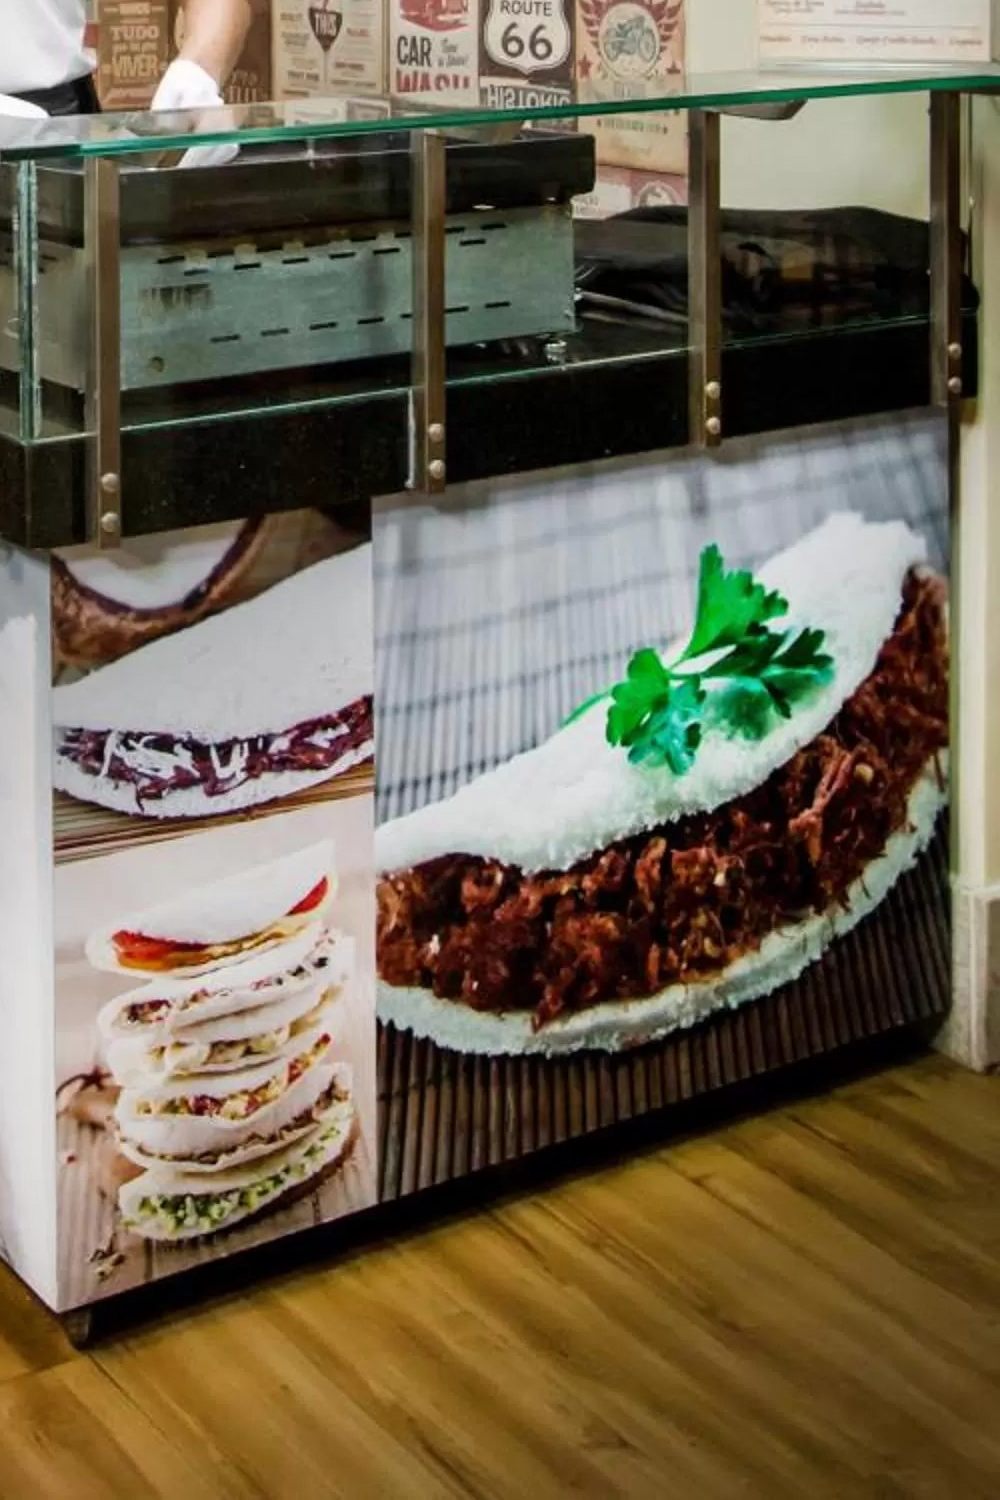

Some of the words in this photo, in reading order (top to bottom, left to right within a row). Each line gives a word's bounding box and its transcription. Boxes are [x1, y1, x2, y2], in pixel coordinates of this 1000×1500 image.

[499, 0, 553, 18] ROUTE
[109, 25, 160, 41] TUDO
[314, 12, 337, 36] THIS
[396, 34, 432, 67] CAR
[501, 21, 554, 61] 66
[111, 53, 159, 77] VIVER
